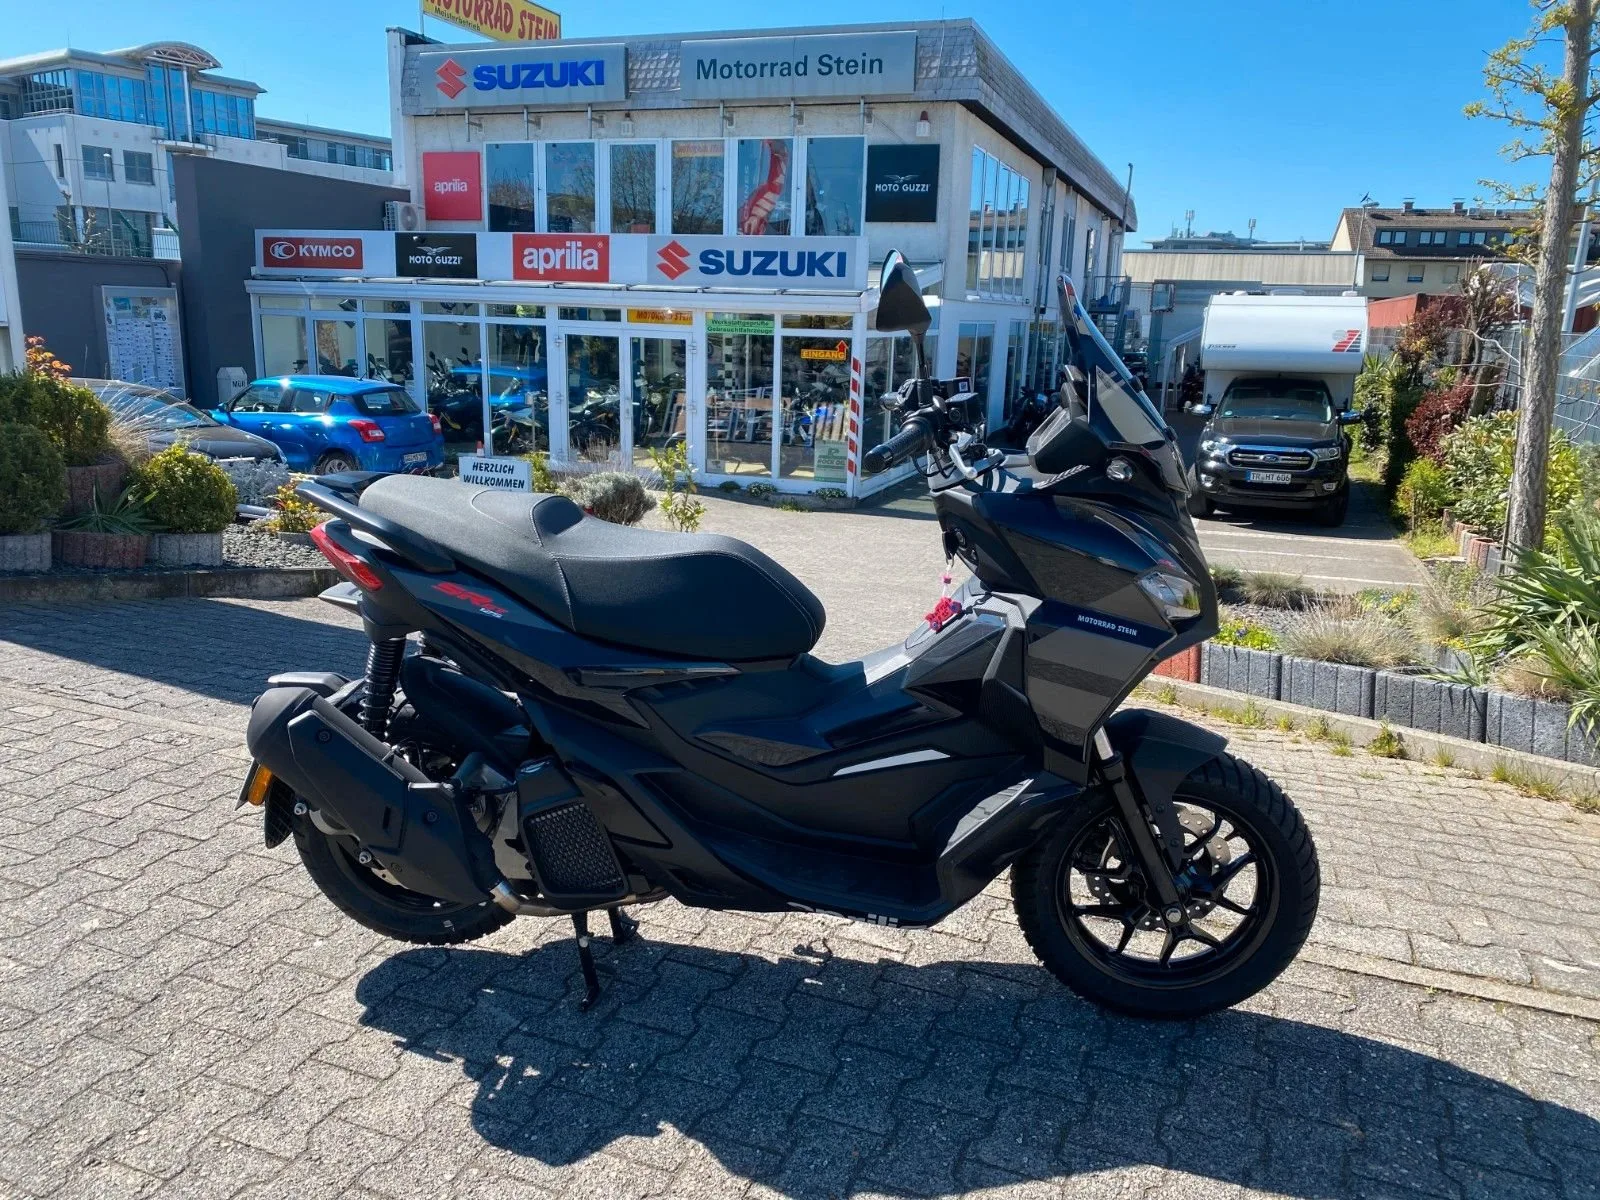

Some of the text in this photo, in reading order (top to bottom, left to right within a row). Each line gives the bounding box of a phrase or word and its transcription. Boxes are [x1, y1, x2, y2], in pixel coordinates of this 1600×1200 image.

[424, 0, 558, 40] ORRAD STEIN
[434, 7, 481, 32] Meisterbetrieb
[473, 60, 605, 91] SUZUKI
[696, 52, 884, 80] Motorrad Stein
[434, 178, 468, 194] aprilia
[875, 183, 929, 192] MOTO GUZZI
[298, 244, 355, 258] KYMCO
[408, 255, 462, 265] MOTO GUZZI
[522, 240, 599, 275] aprilia
[699, 248, 847, 278] SUZUKI
[802, 350, 845, 359] EINGANG
[472, 462, 515, 475] HERZLICH
[463, 474, 525, 489] WILLKOMMEN
[1077, 614, 1138, 637] MOTORRAD STEIN
